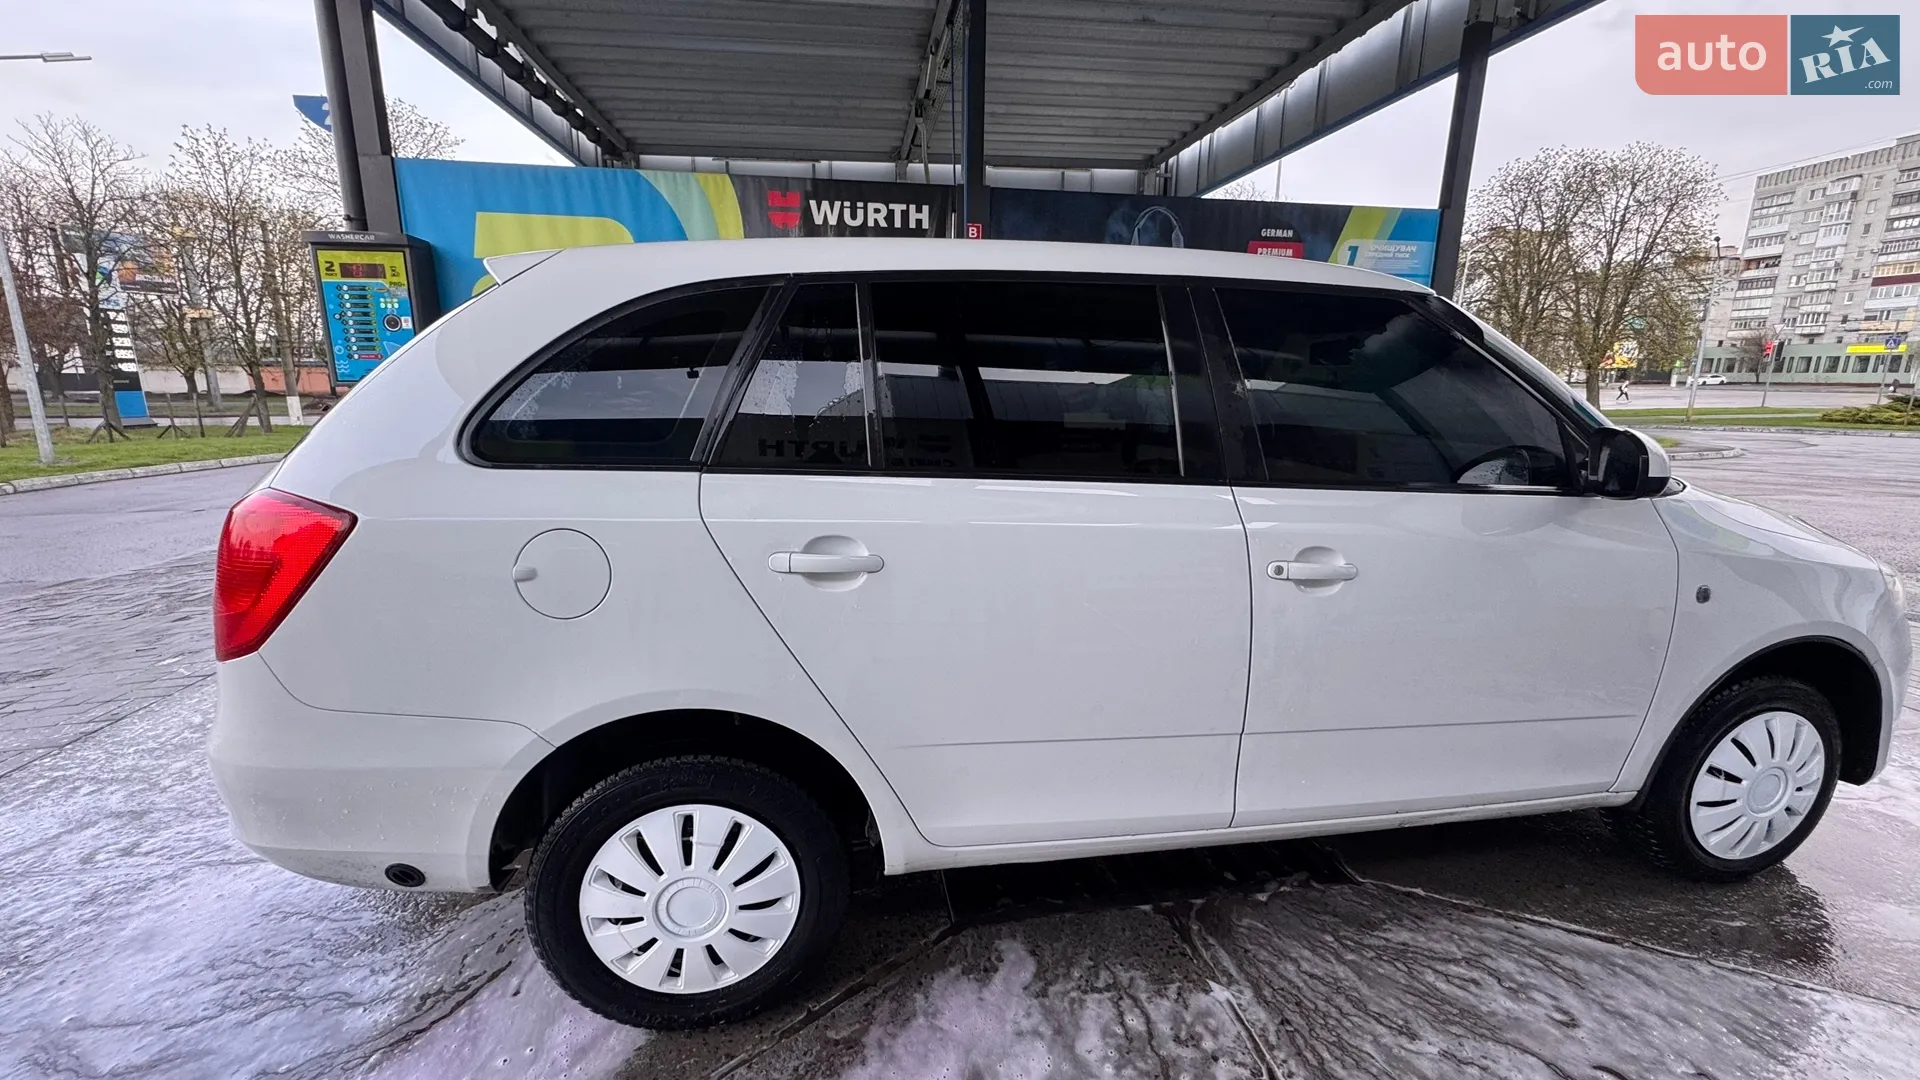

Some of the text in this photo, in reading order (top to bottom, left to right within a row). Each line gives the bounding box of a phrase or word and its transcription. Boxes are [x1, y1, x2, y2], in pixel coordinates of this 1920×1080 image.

[808, 199, 931, 230] WÜRTH
[1261, 228, 1293, 237] GERMAN
[1257, 247, 1293, 256] PREMIUM
[324, 260, 335, 272] 2
